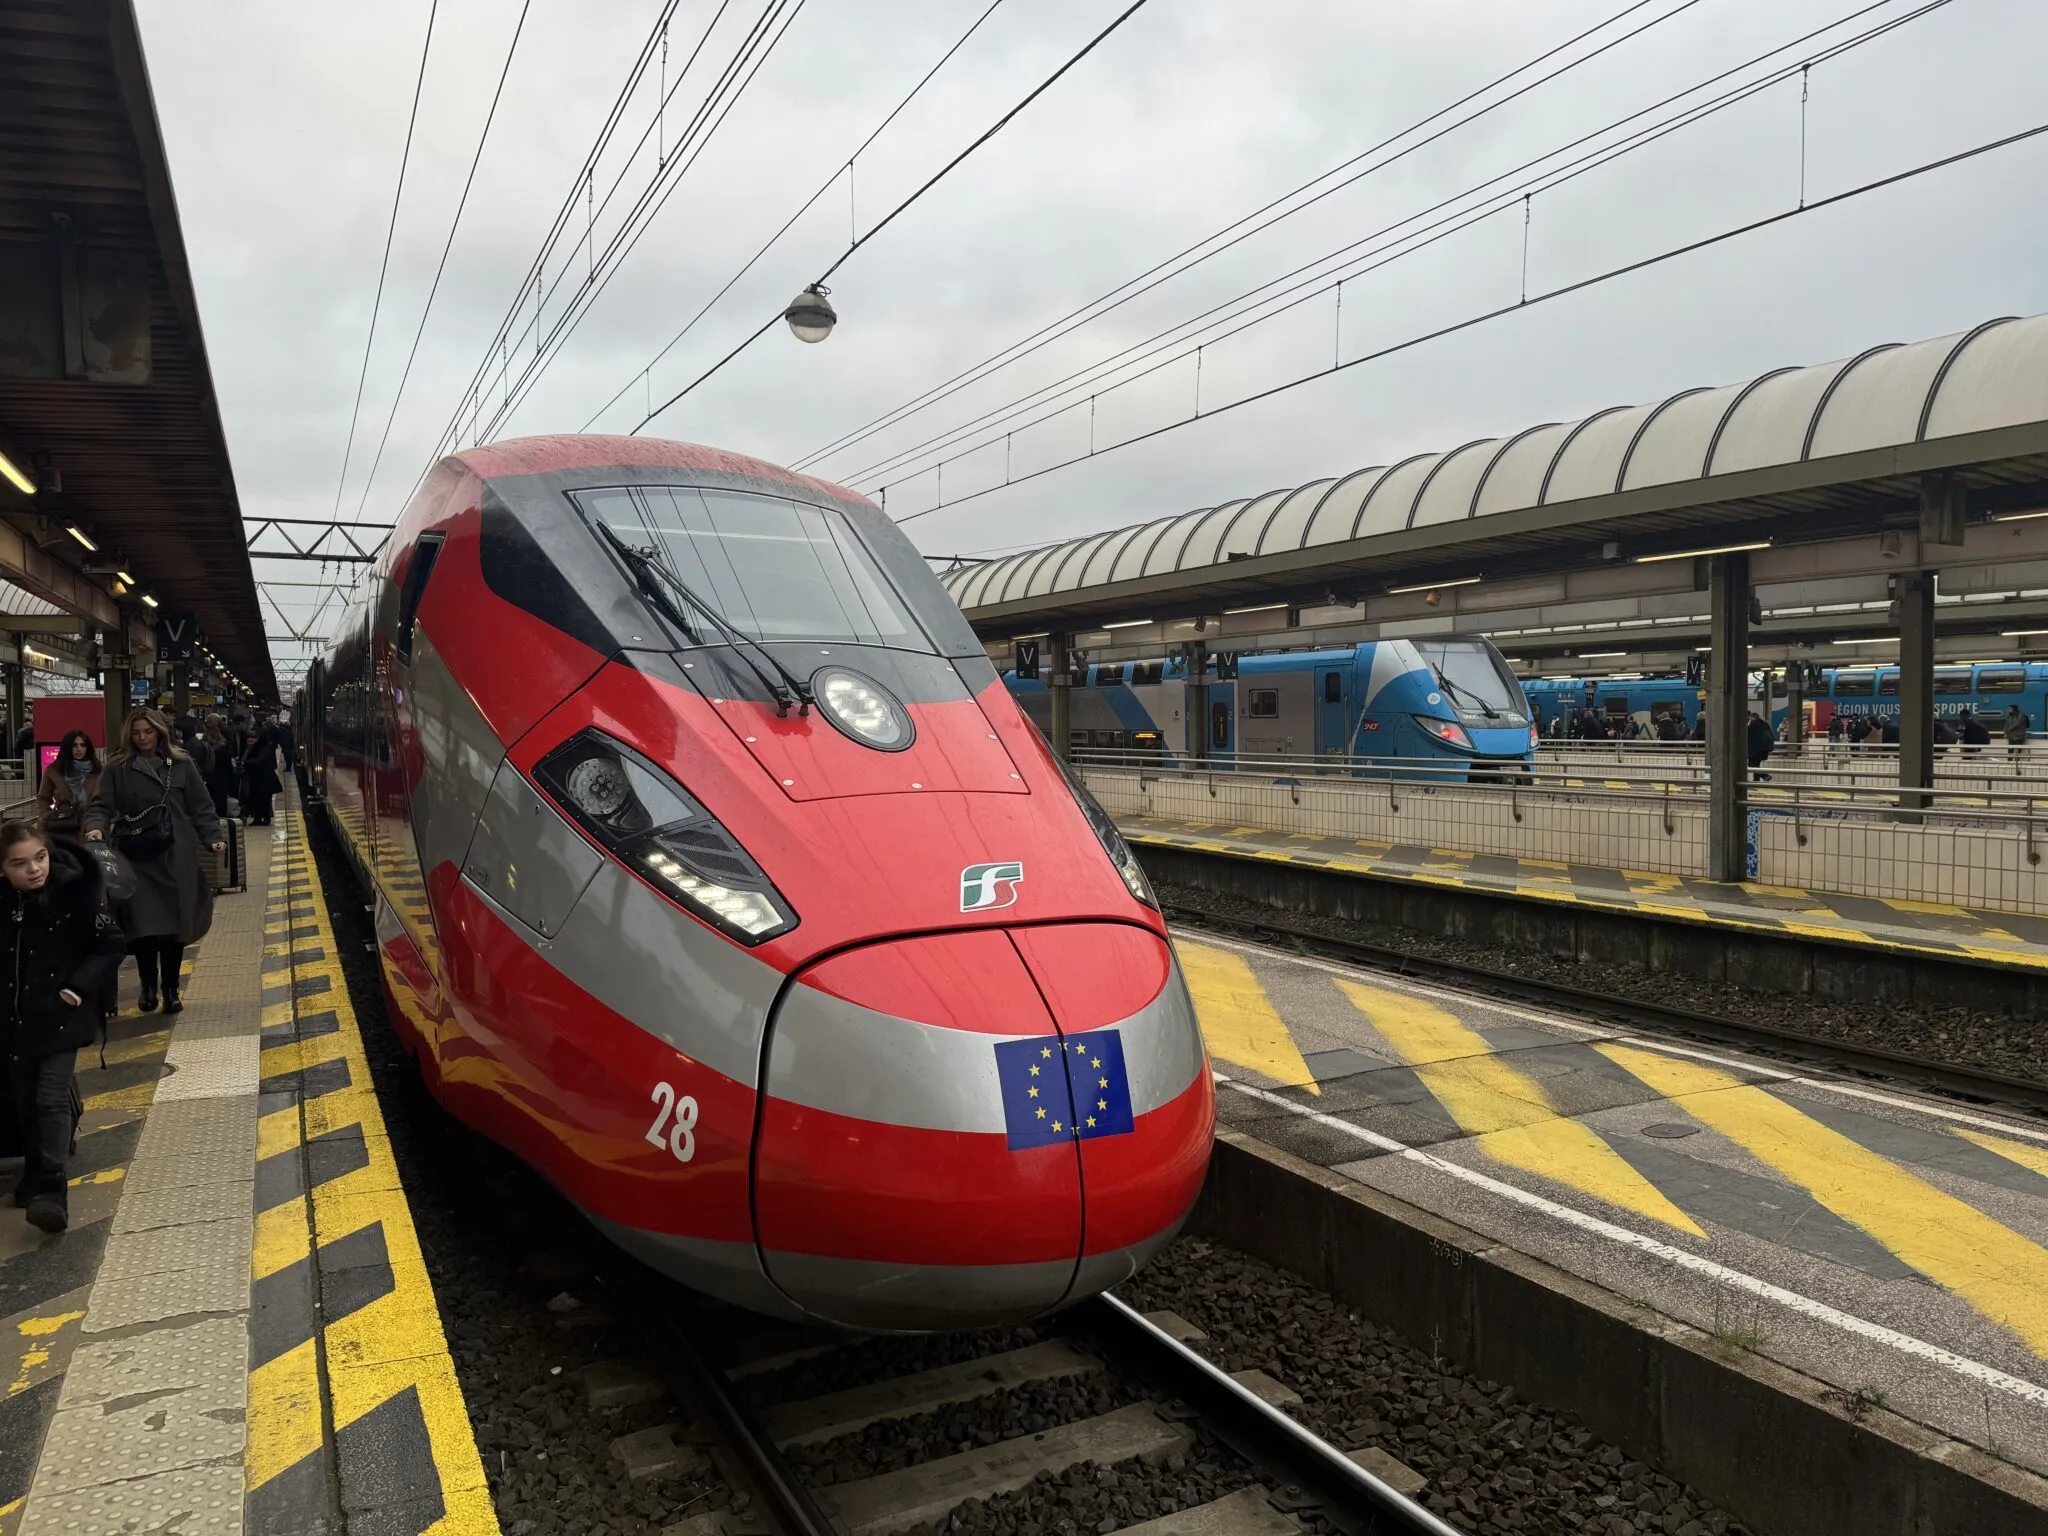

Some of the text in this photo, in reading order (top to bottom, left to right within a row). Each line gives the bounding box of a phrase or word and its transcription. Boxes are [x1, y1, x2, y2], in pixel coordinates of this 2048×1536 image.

[164, 619, 185, 642] V
[1021, 647, 1034, 665] V
[1223, 651, 1234, 666] V
[1690, 660, 1699, 675] V
[1834, 702, 1979, 715] ÉGION VOUS SPORTE
[645, 1081, 699, 1163] 28
